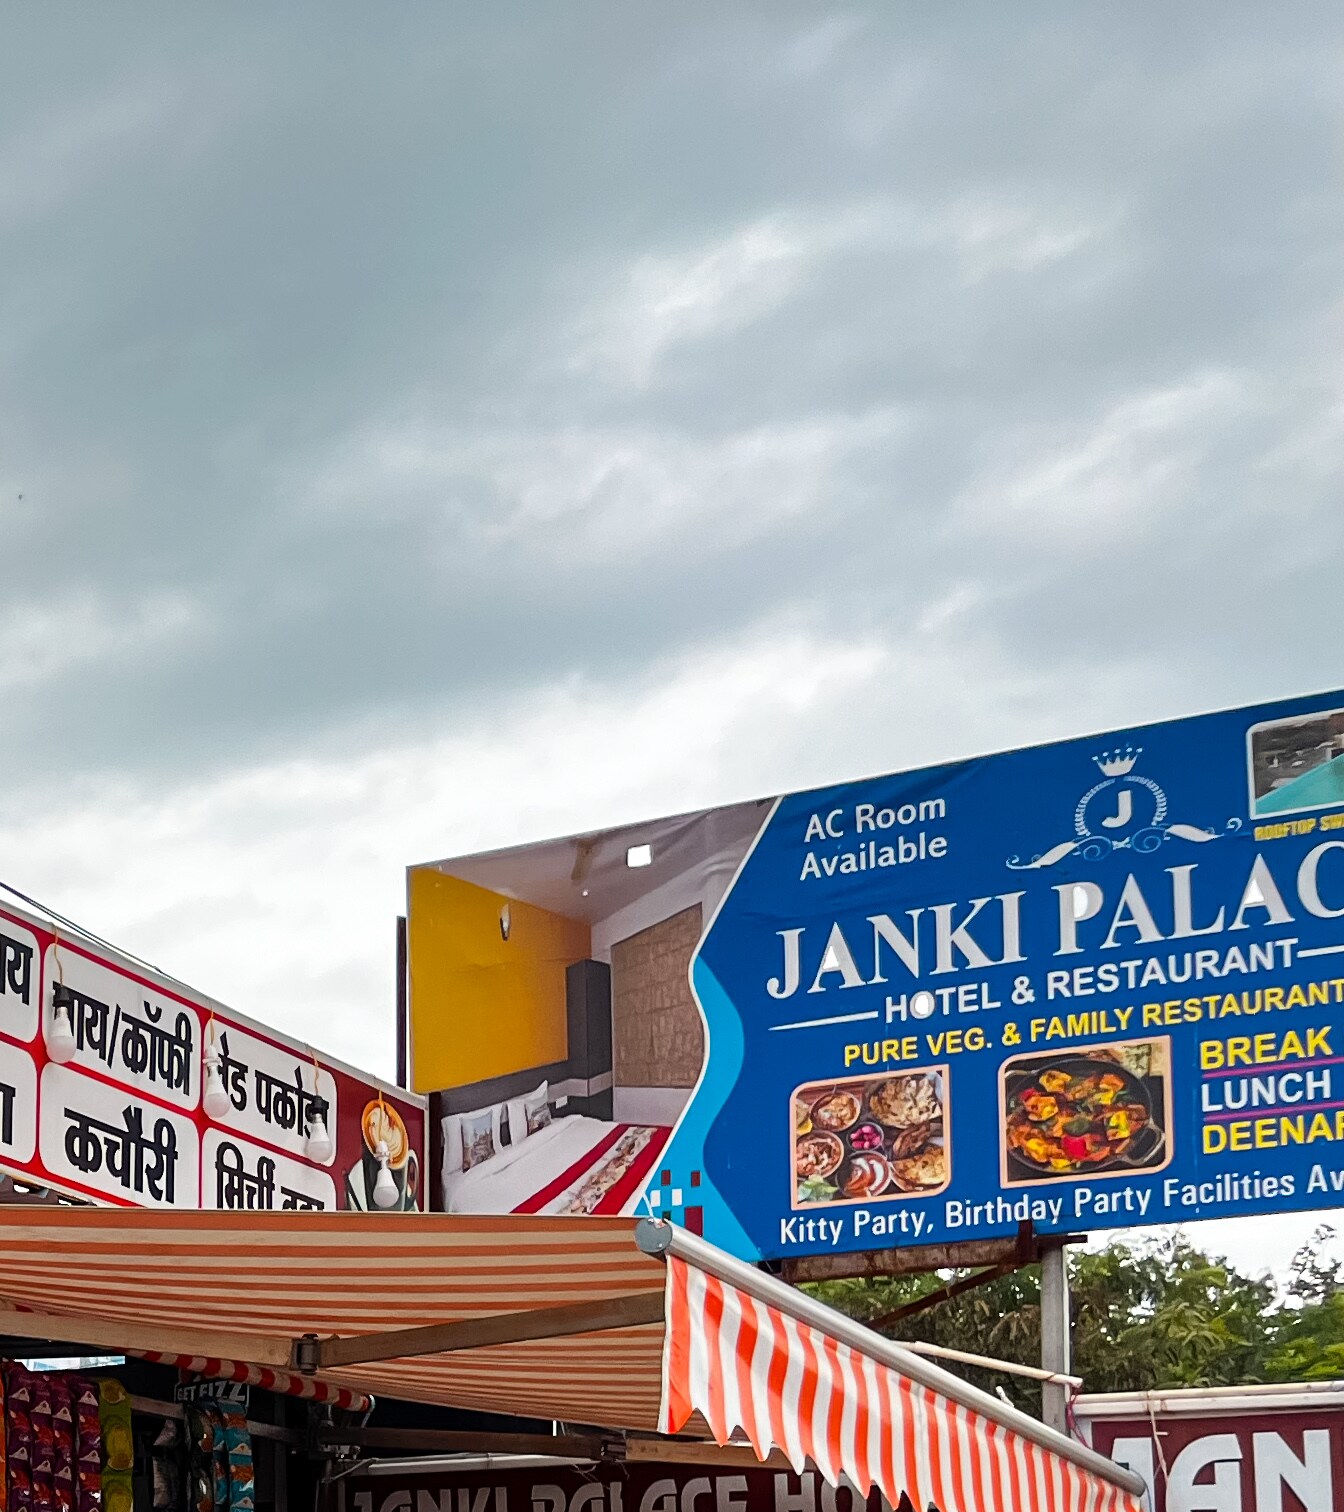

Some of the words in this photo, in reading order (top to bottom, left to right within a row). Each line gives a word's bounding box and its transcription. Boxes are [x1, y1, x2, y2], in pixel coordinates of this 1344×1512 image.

[800, 832, 948, 881] Available
[804, 809, 844, 842] AC
[855, 798, 946, 833] Room
[766, 890, 1028, 999] JANKI
[1051, 841, 1344, 956] PALAC
[885, 982, 1001, 1023] HOTEL
[1011, 975, 1036, 1005] &
[1047, 937, 1299, 1000] RESTAURANT
[844, 1034, 918, 1067] PURE
[926, 1027, 993, 1057] VEG.
[1001, 1022, 1022, 1047] &
[1030, 1006, 1134, 1043] FAMILY
[1142, 979, 1344, 1028] RESTAURANT
[1199, 1025, 1334, 1071] BREAK
[1201, 1069, 1331, 1113] LUNCH
[64, 1105, 179, 1204] कचौरी
[779, 1214, 842, 1246] Kitty
[853, 1203, 935, 1240] Party,
[945, 1192, 1062, 1227] Birthday
[1074, 1187, 1152, 1217] Party
[1164, 1171, 1296, 1207] Facilities
